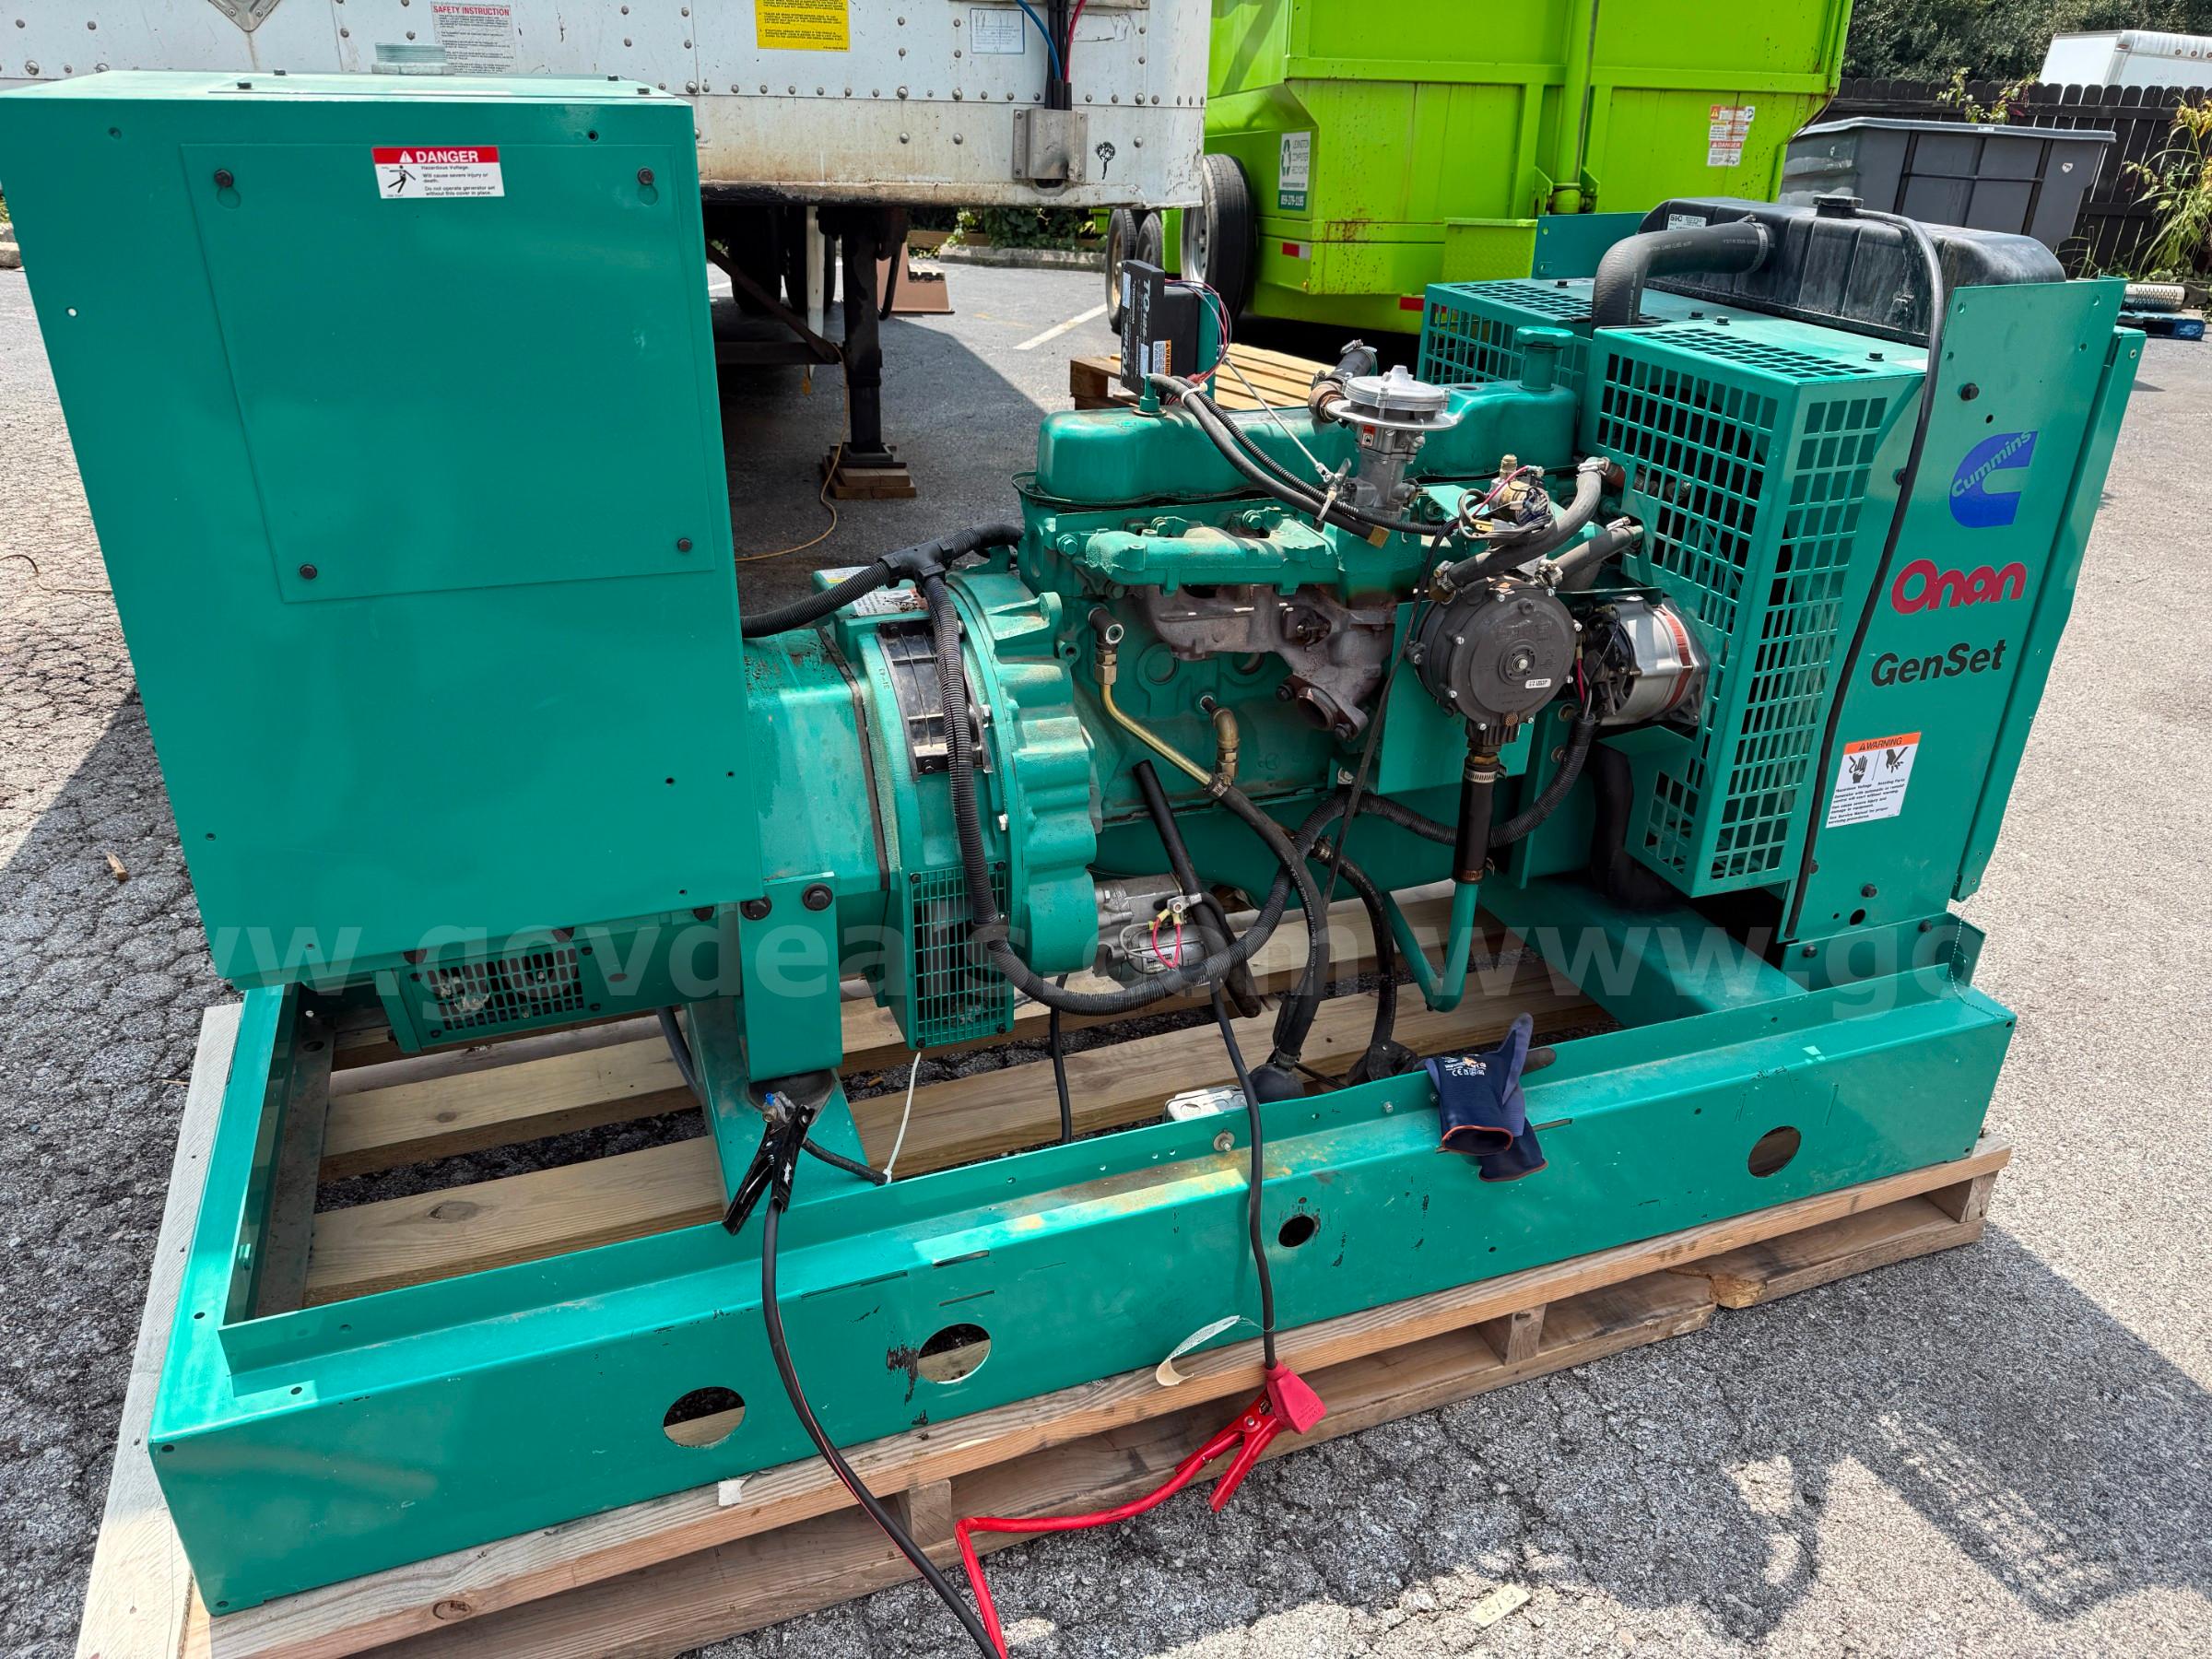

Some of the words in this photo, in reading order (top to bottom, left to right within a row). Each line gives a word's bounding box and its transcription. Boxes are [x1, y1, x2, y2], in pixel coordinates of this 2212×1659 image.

[433, 6, 460, 14] SAFETY
[462, 6, 510, 16] INSTRUCTION
[416, 150, 479, 163] DANGER
[1951, 431, 2032, 498] Cummins
[1891, 559, 2027, 616] Onan
[1871, 639, 2006, 687] GenSet
[1866, 737, 1903, 750] WARNING
